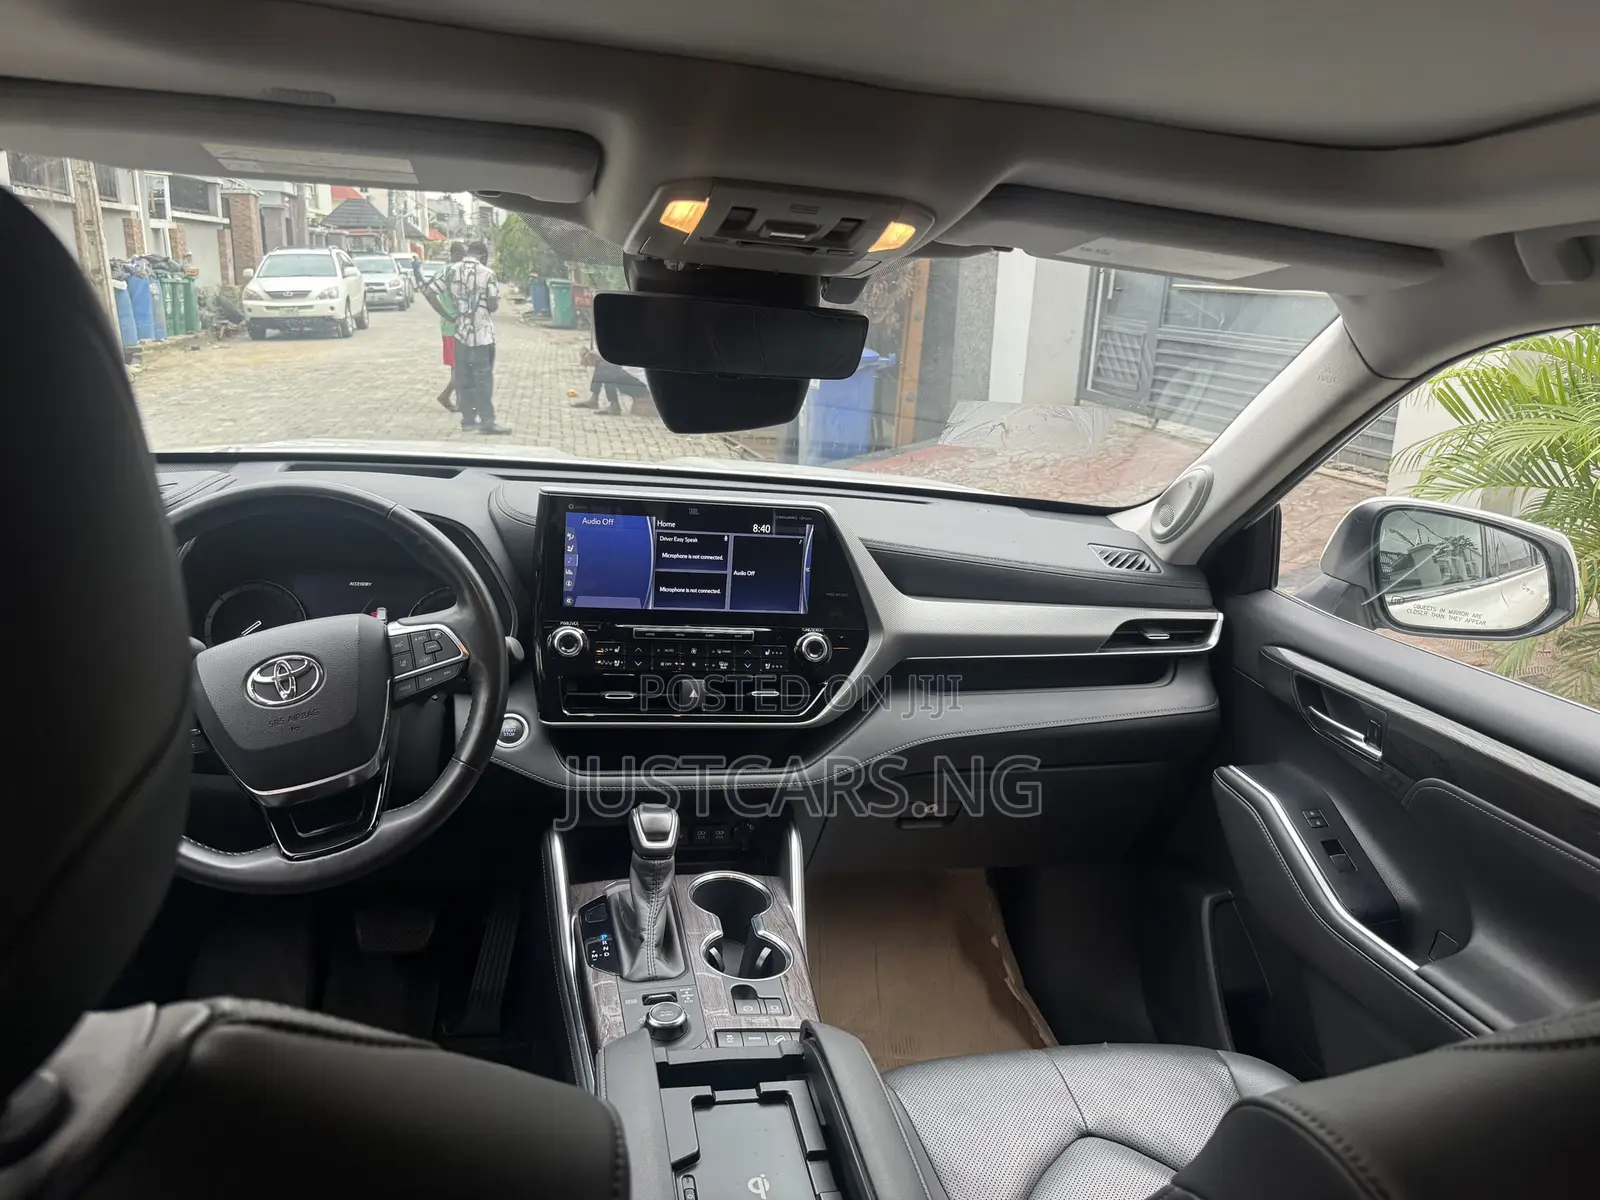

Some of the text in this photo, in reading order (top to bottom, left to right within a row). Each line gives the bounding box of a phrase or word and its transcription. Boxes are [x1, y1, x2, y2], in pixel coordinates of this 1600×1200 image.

[581, 517, 615, 526] Audio Off
[656, 520, 676, 528] Home
[752, 524, 771, 534] 8:40
[661, 552, 688, 560] Microphone
[659, 586, 686, 594] Microphone
[1413, 603, 1437, 612] OBJECTS
[1448, 609, 1470, 617] MIRROR
[1406, 608, 1428, 616] CLOSER
[1448, 614, 1462, 622] THEY
[1464, 618, 1487, 626] APPEAR
[268, 708, 319, 728] SRS AIRBAG
